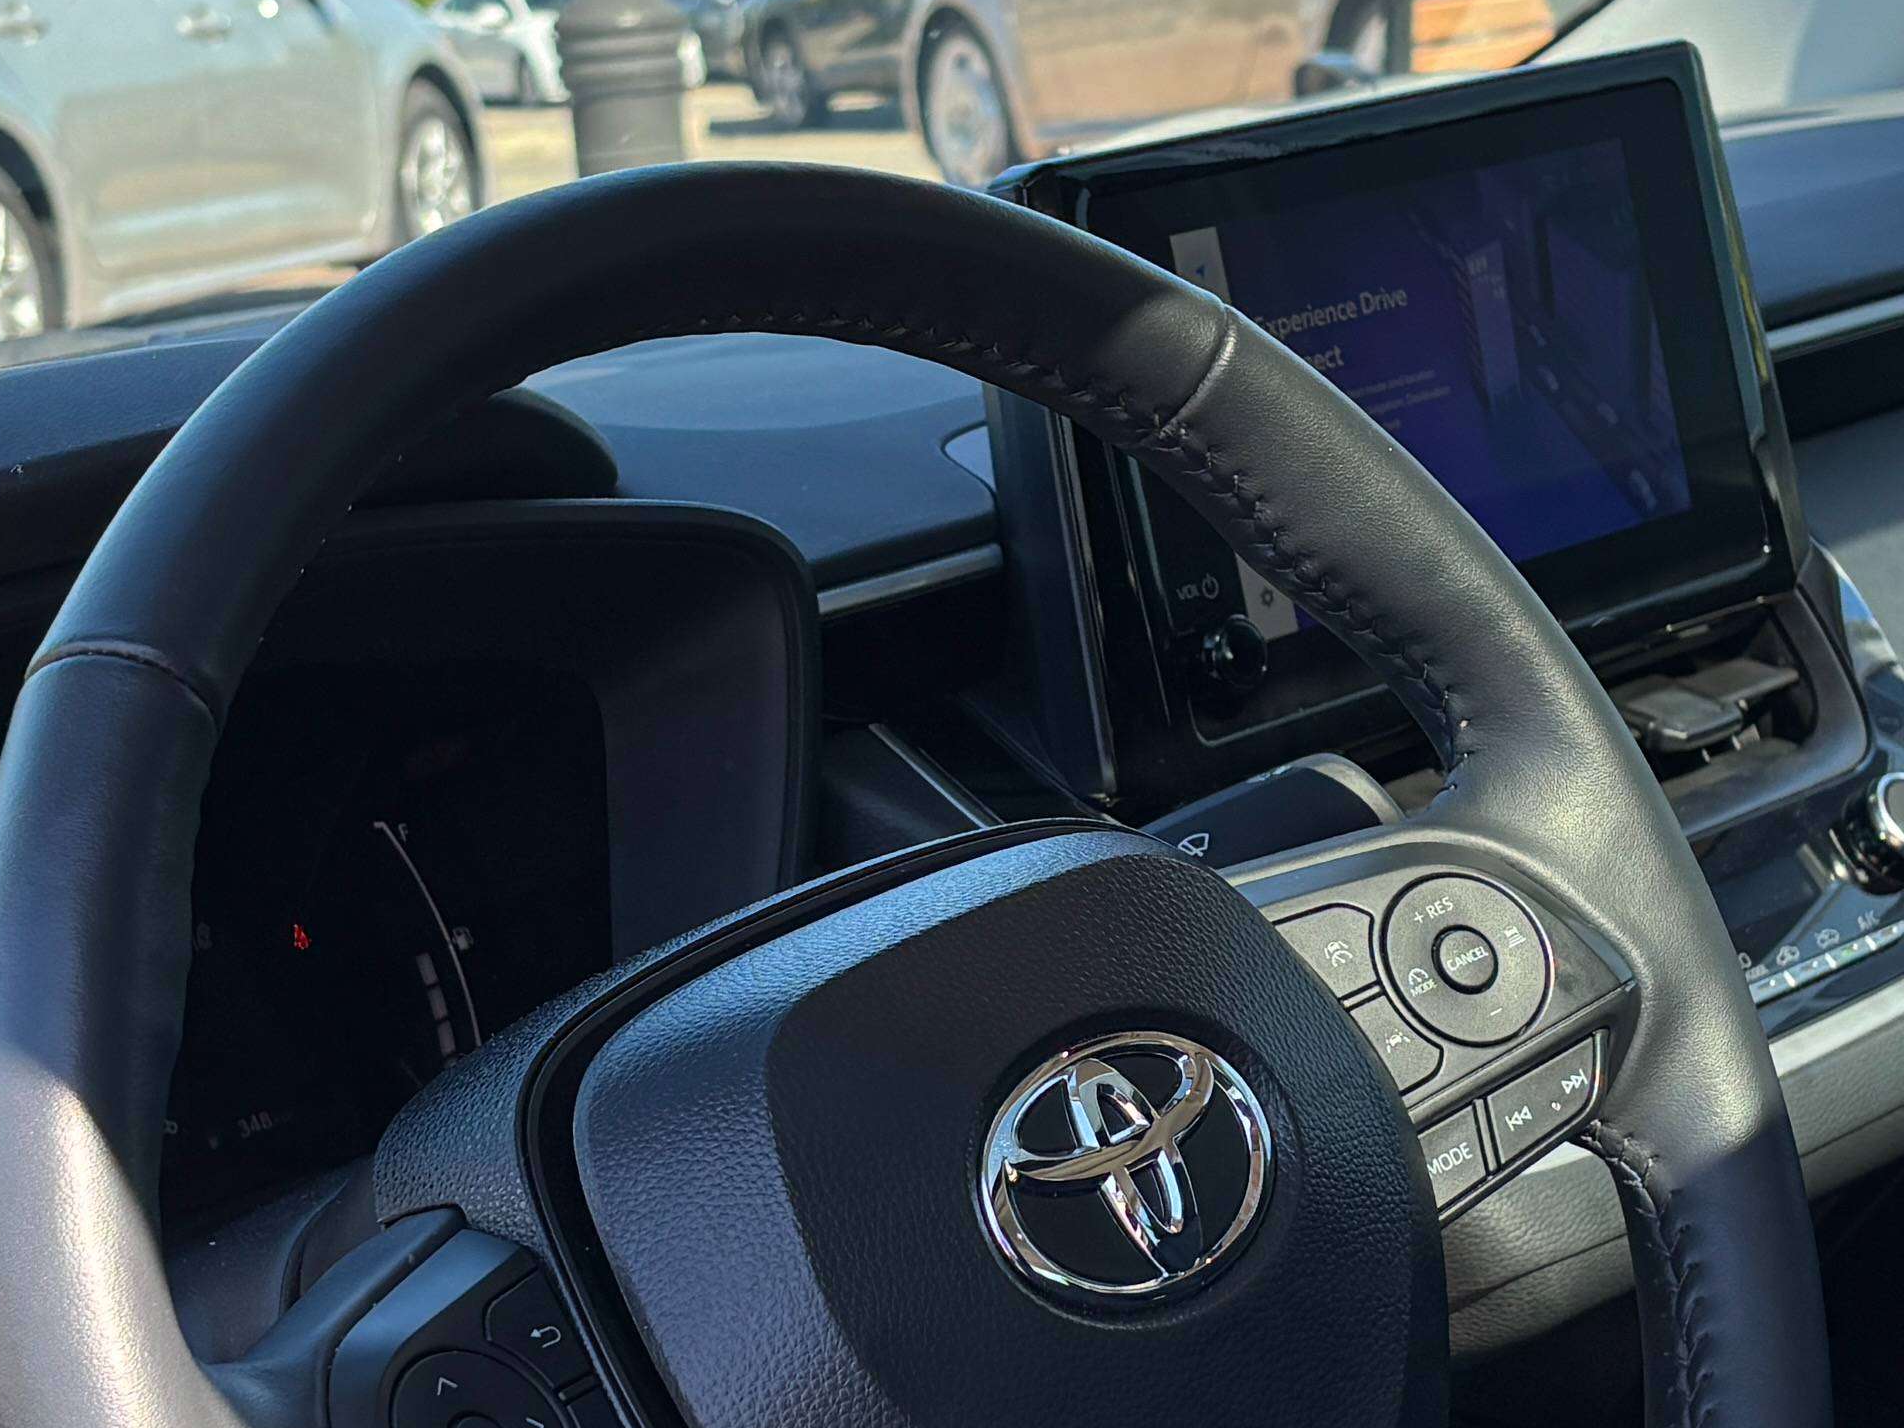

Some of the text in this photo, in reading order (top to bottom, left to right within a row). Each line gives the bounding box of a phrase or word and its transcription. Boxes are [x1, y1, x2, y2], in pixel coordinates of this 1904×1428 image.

[1359, 286, 1409, 315] Drive
[1426, 895, 1454, 920] RES
[1446, 945, 1489, 974] CANCEL
[1410, 977, 1438, 999] MODE
[1427, 1140, 1474, 1179] MODE
